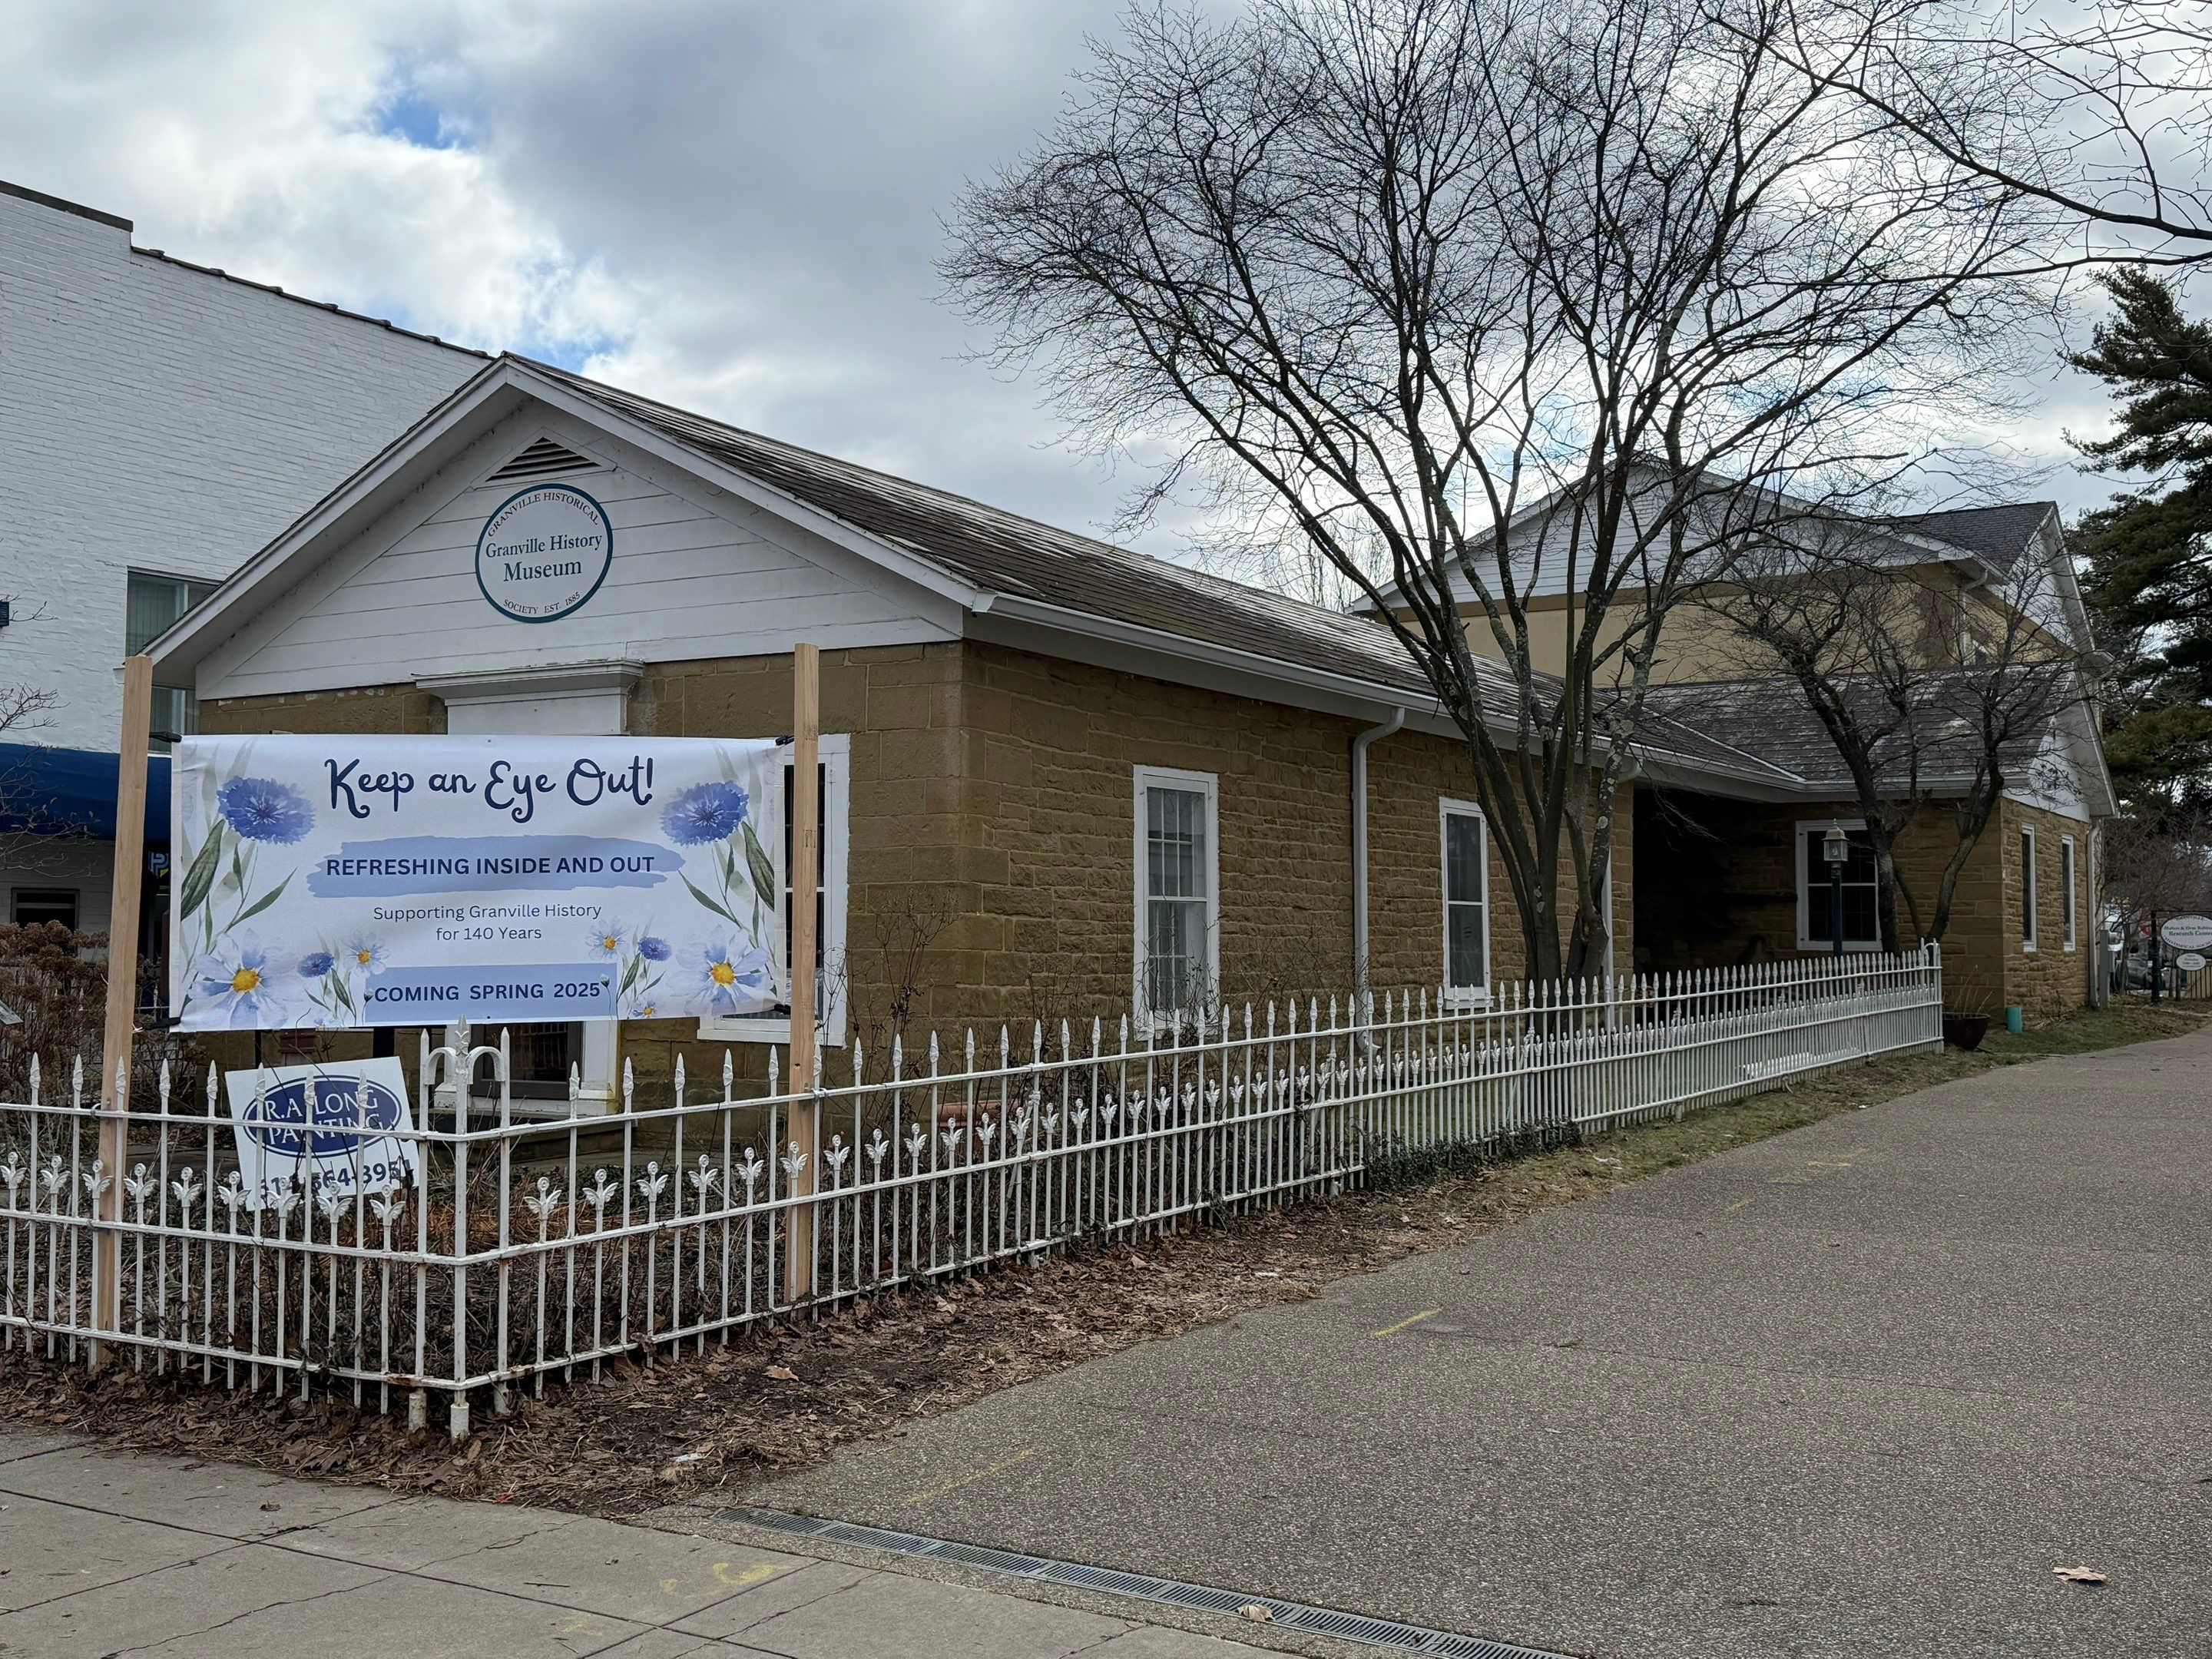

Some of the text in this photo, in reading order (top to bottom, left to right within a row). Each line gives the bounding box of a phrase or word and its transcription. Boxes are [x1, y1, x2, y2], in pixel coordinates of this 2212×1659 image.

[487, 492, 600, 538] GRANVILLE HISTORICAL
[485, 534, 603, 558] Granville History
[503, 560, 582, 582] Museum
[503, 591, 581, 614] SOCIETY EST. 1885
[323, 755, 654, 824] Keep an Eye Out!
[326, 856, 655, 876] REFRESHING INSIDE AND OUT
[373, 904, 602, 923] Supporting Granville History
[435, 926, 542, 941] for 140 Years
[374, 982, 601, 1002] COMING SPRING 2025
[314, 1089, 379, 1115] LONG
